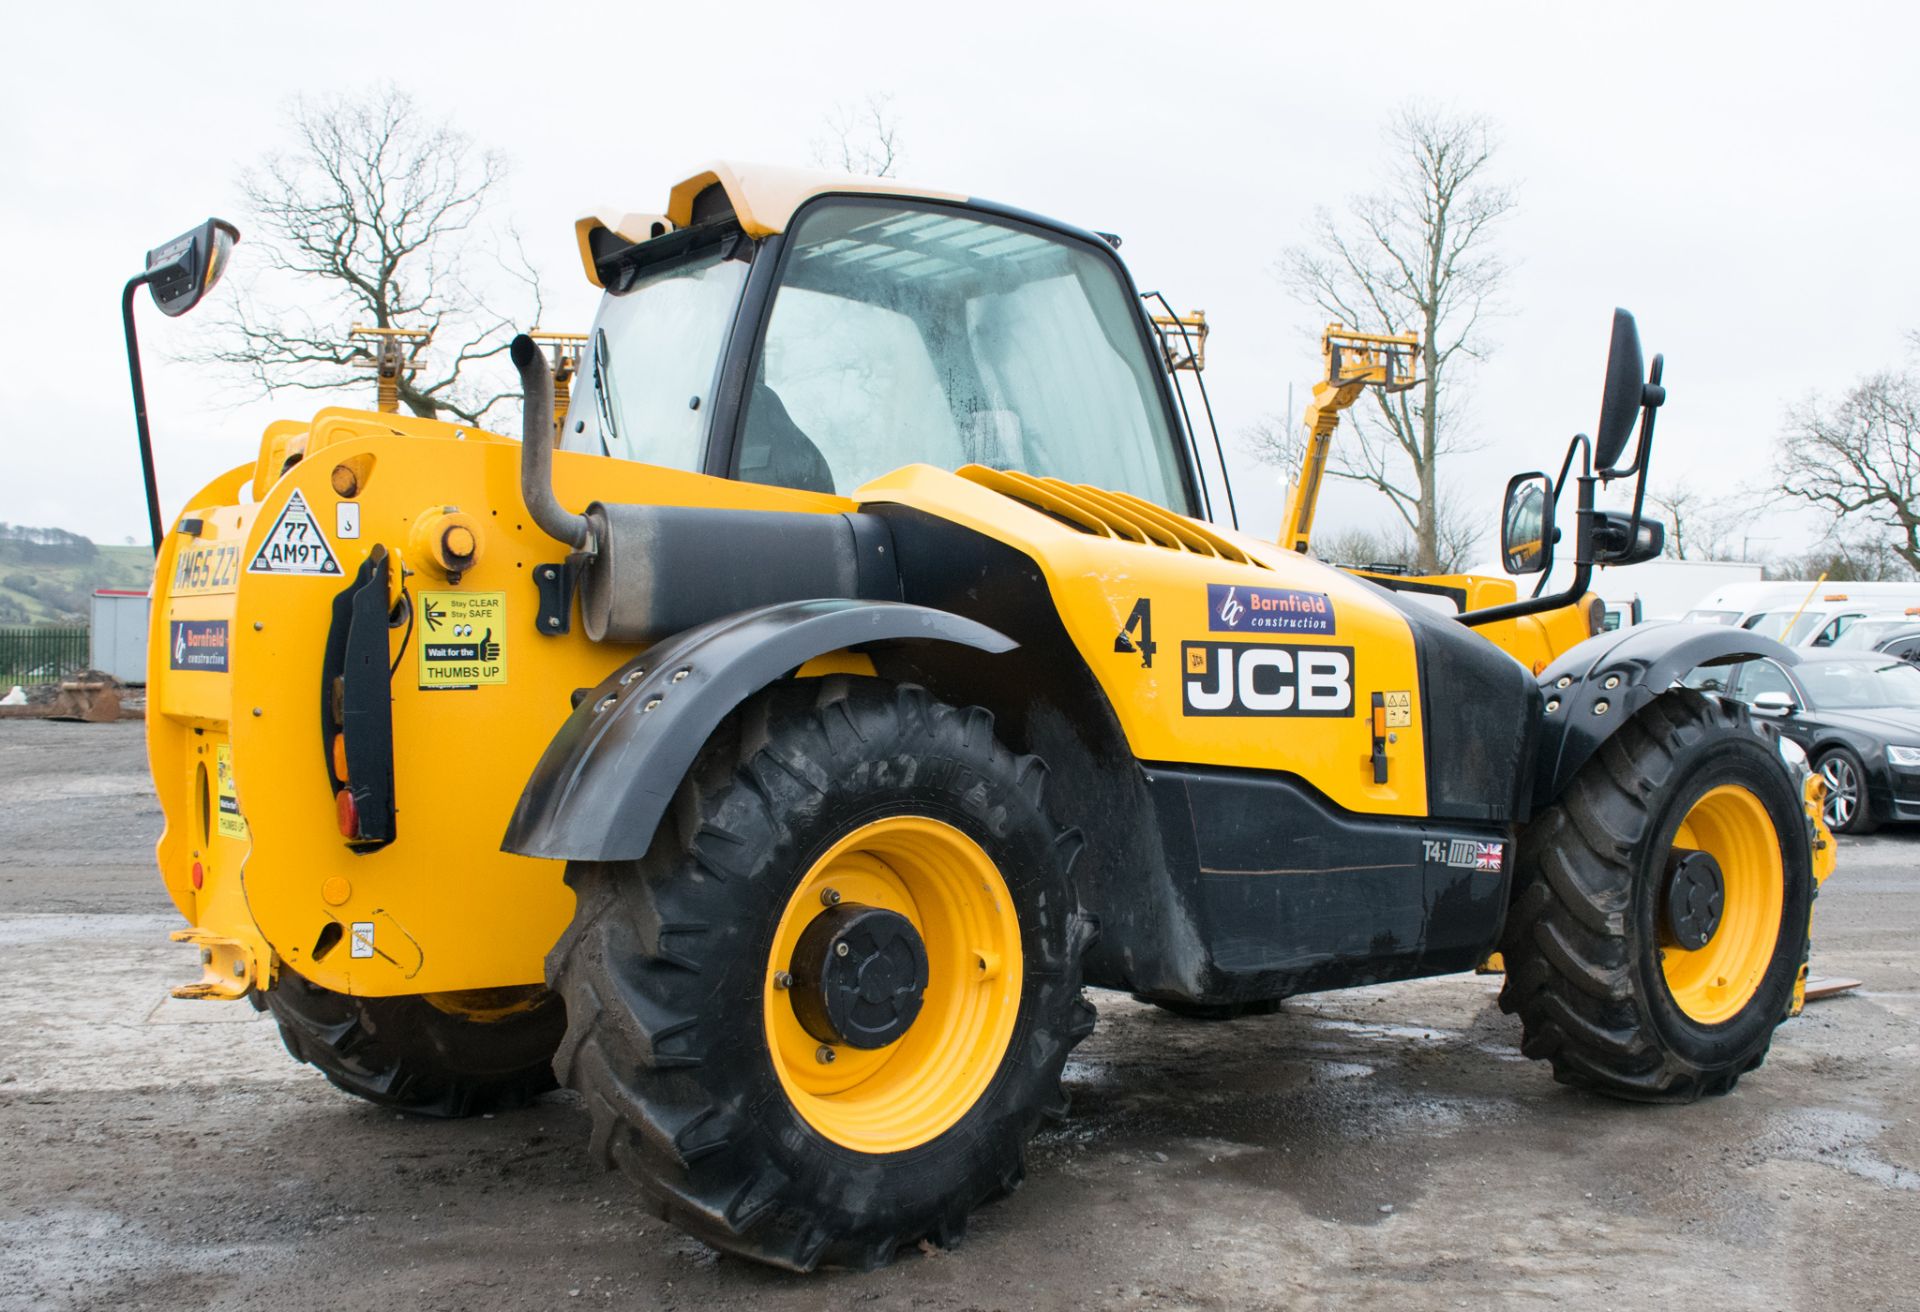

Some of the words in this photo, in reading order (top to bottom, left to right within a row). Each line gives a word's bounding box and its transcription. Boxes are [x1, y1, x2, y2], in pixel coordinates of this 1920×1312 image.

[284, 522, 308, 542] 77
[271, 543, 322, 564] AM9T
[451, 600, 467, 608] Stay
[468, 599, 499, 607] CLEAR
[1251, 593, 1326, 614] Barnfield
[451, 611, 467, 619] Stay
[469, 610, 493, 618] SAFE
[1251, 615, 1327, 630] construction
[187, 627, 225, 647] Barnfield
[1113, 597, 1157, 669] 4
[188, 652, 225, 665] construction
[428, 648, 446, 657] Wait
[447, 648, 459, 657] for
[460, 647, 474, 656] the
[427, 666, 480, 678] THUMBS
[483, 666, 500, 677] UP
[1187, 648, 1352, 711] JCB
[1422, 840, 1447, 863] T4i
